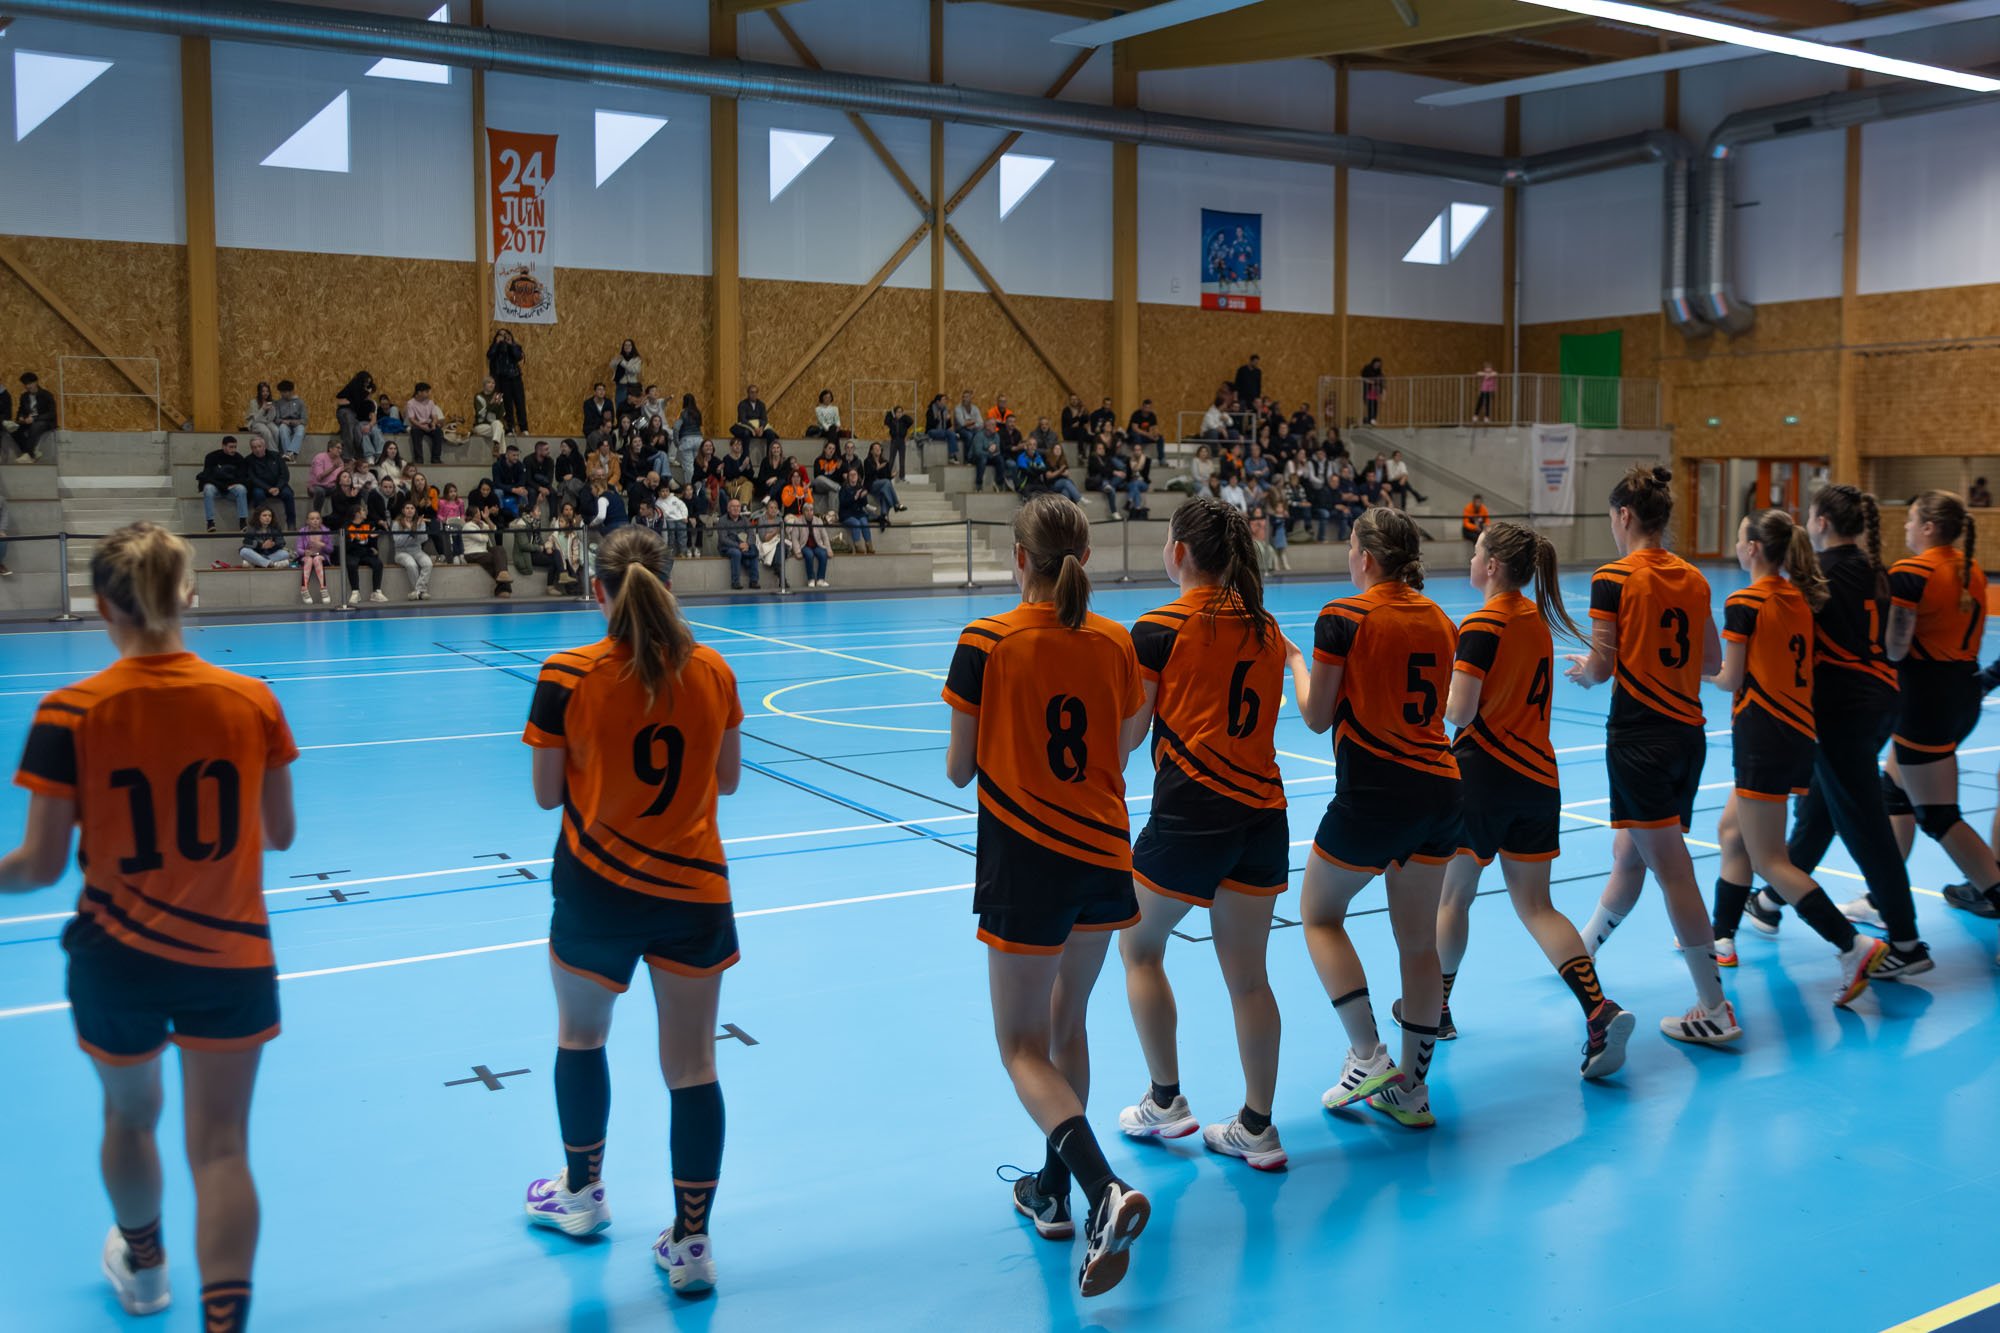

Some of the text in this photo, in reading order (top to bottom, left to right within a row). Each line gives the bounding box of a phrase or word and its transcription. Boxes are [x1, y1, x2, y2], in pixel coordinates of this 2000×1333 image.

[498, 148, 546, 197] 24
[501, 227, 546, 254] 2017
[1658, 607, 1692, 669] 3
[1788, 634, 1808, 688] 2
[1227, 660, 1262, 739] 6
[1402, 652, 1438, 728] 5
[1525, 656, 1550, 721] 4
[632, 721, 686, 819] 9
[1045, 693, 1089, 784] 8
[109, 757, 241, 876] 10
